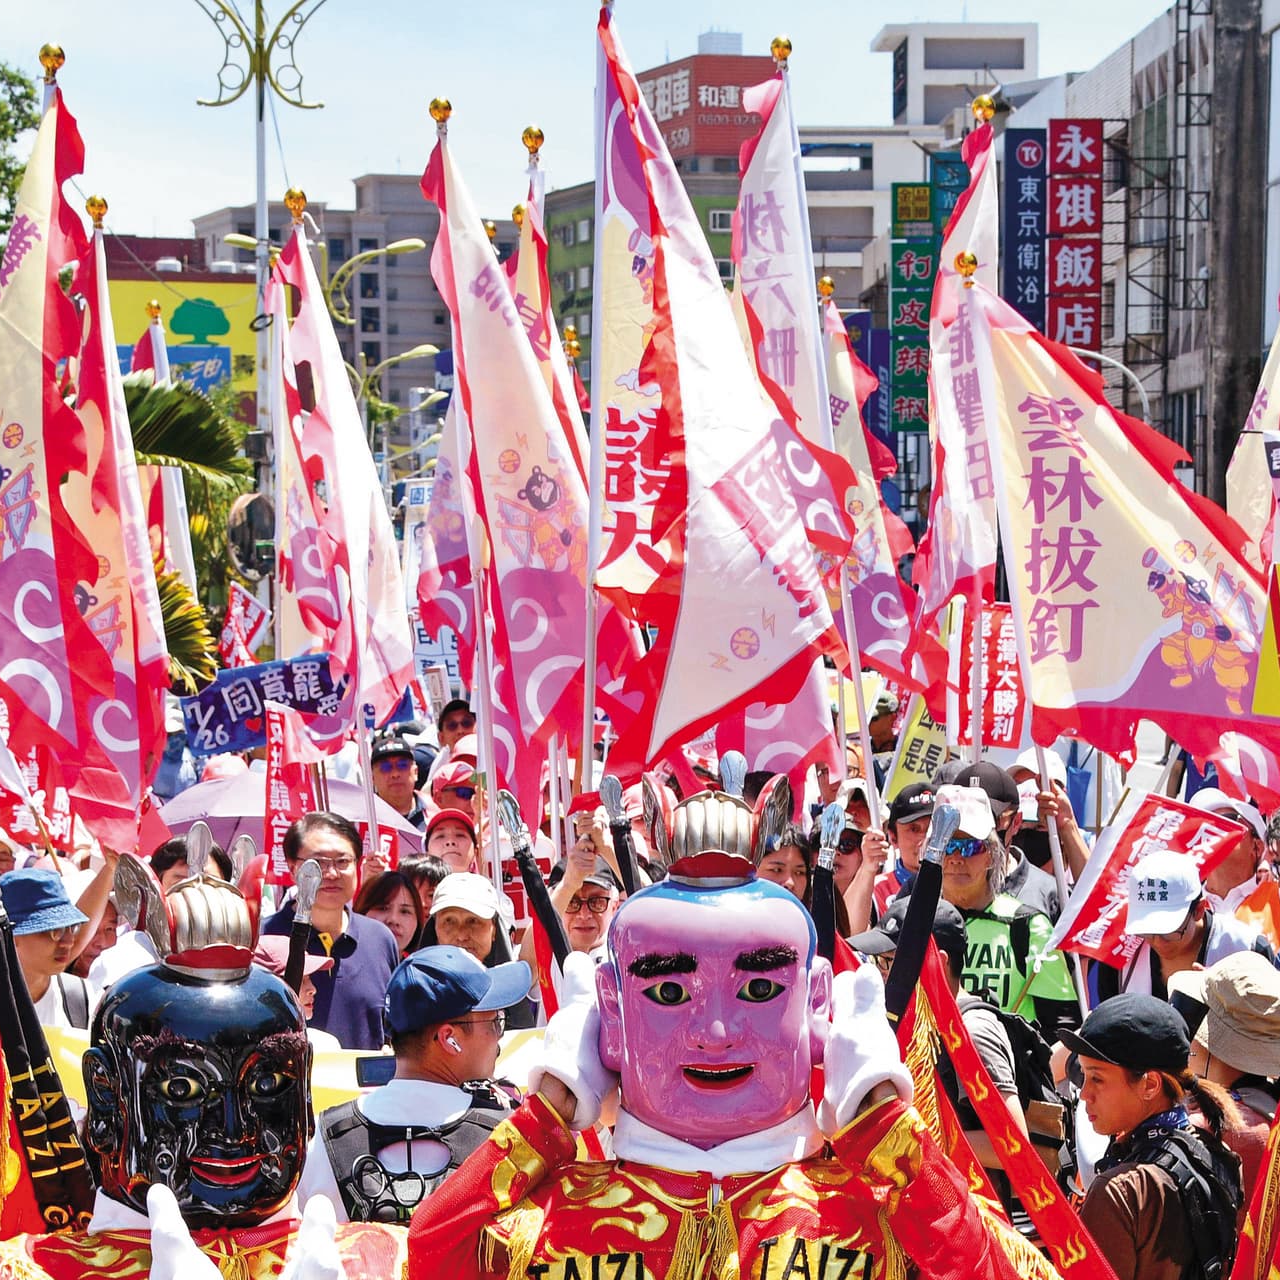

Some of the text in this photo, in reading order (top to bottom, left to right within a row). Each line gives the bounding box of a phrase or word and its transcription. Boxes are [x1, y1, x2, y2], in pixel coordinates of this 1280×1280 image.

[697, 85, 744, 109] 和運
[1017, 176, 1041, 305] 東京衛浴
[1053, 124, 1098, 346] 永祺飯店
[1018, 393, 1106, 665] 雲林拔釘
[185, 700, 231, 752] 7/26
[991, 613, 1019, 742] 台灣大勝利
[1137, 890, 1169, 902] 大成宮
